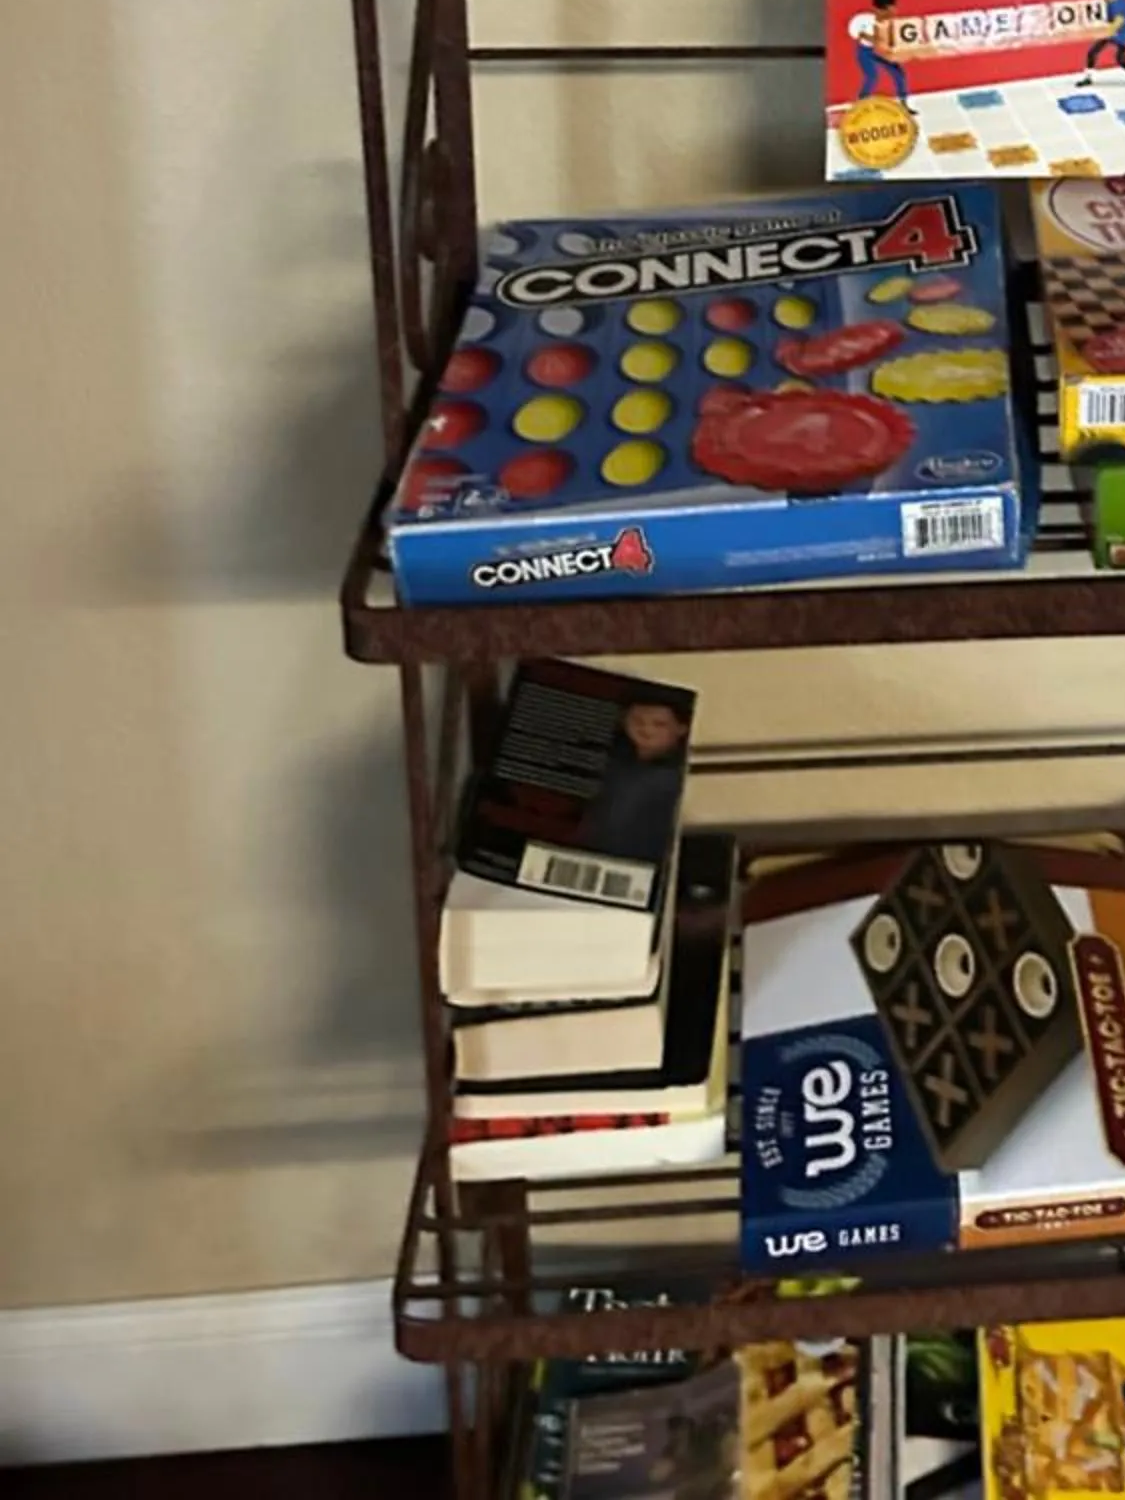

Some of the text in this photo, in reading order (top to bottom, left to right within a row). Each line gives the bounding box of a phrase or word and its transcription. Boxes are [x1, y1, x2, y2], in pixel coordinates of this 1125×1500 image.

[506, 227, 876, 303] CONNECT
[874, 198, 970, 267] 4
[473, 546, 613, 588] CONNECT
[801, 1060, 857, 1178] we
[859, 1068, 893, 1150] GAMES
[764, 1223, 901, 1257] we GAMES
